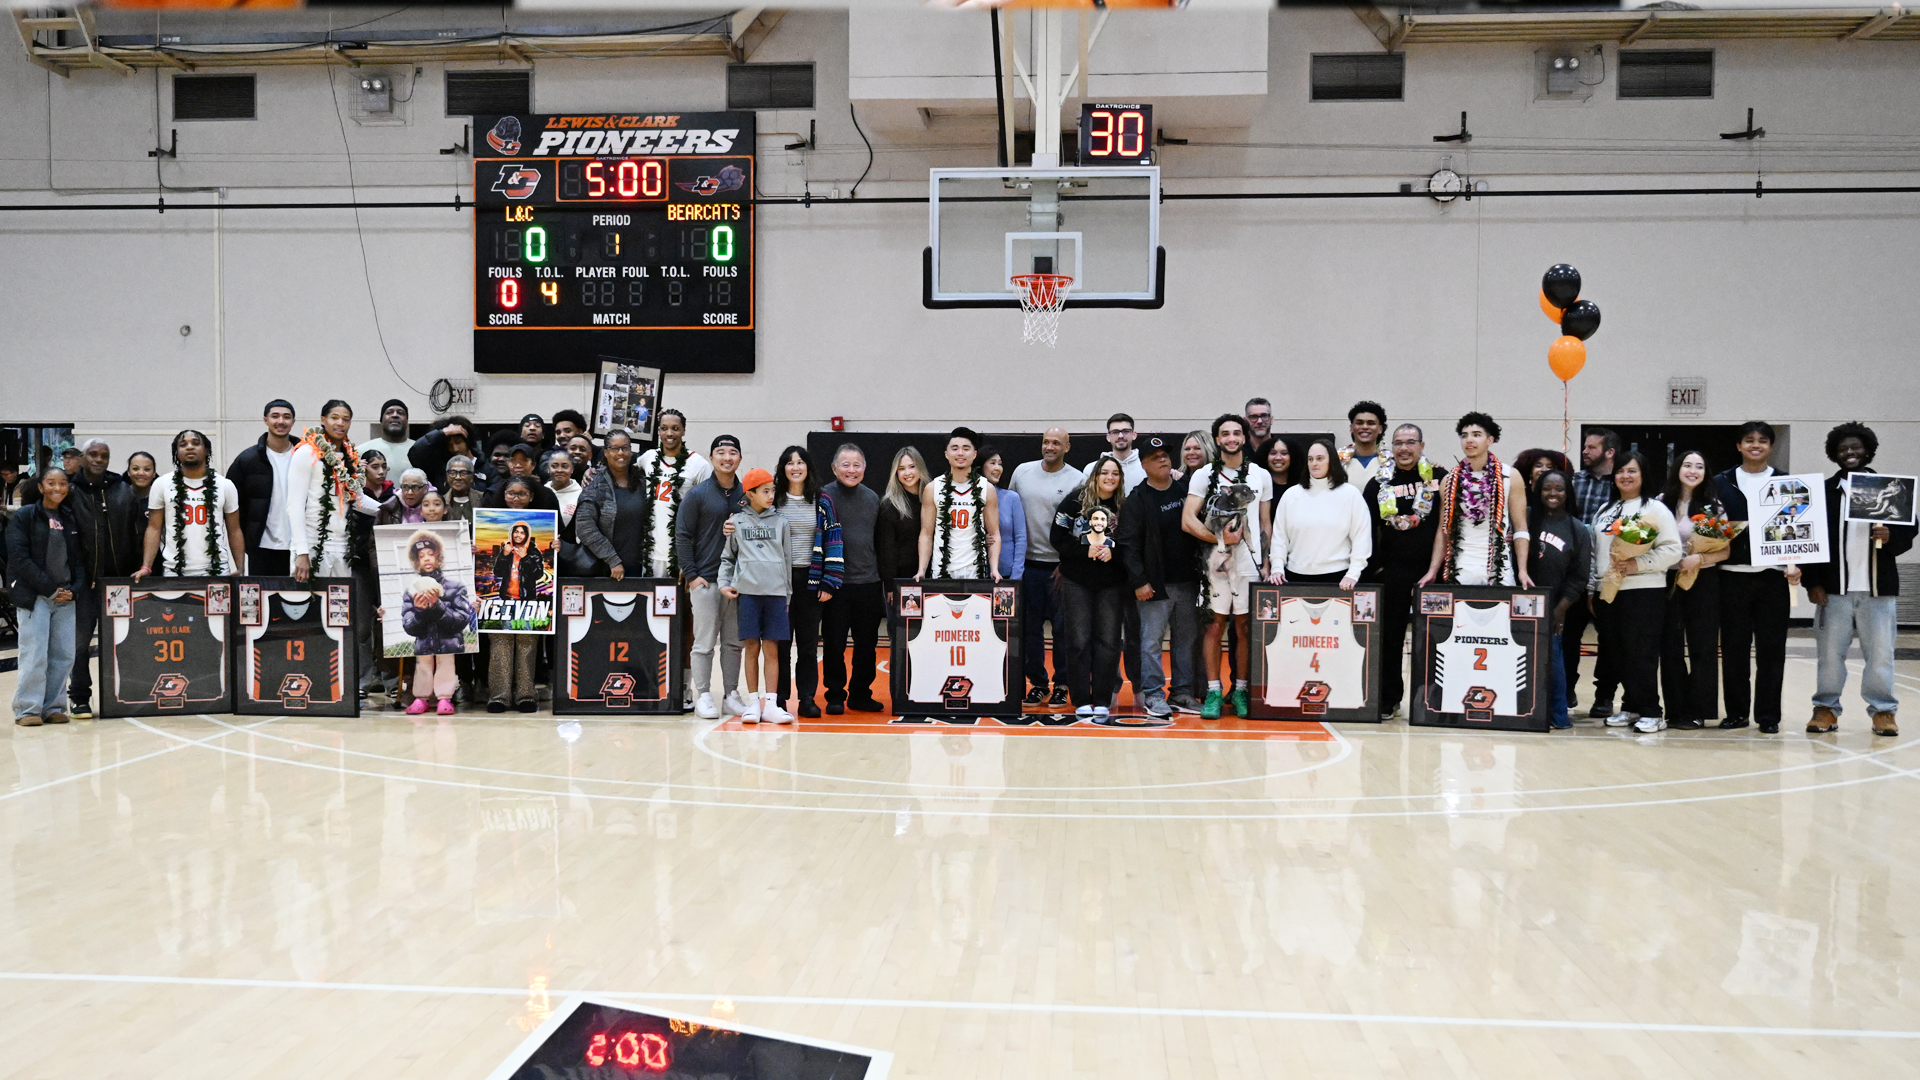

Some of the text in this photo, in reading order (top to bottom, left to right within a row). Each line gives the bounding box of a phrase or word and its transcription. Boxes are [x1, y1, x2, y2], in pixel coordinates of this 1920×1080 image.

[532, 129, 740, 156] PIONEERS
[1090, 112, 1143, 157] 30
[585, 161, 662, 198] 5:00
[505, 205, 534, 221] L&C
[593, 215, 631, 227] PERIOD
[667, 204, 741, 221] BEARCATS
[525, 226, 547, 263] 0
[614, 233, 620, 255] 1
[711, 225, 734, 262] 0
[488, 267, 522, 279] FOULS
[535, 267, 564, 279] T.O.L.
[575, 266, 649, 278] PLAYER FOUL
[661, 266, 690, 278] T.O.L.
[703, 266, 738, 278] FOULS
[501, 279, 518, 307] 0
[541, 281, 558, 305] 4
[488, 313, 523, 325] SCORE
[593, 313, 630, 325] MATCH
[703, 313, 738, 325] SCORE
[452, 388, 475, 404] EXIT
[1671, 388, 1699, 405] EXIT
[182, 504, 207, 525] 30
[951, 509, 969, 529] 10
[745, 529, 772, 540] LIBERTY
[1760, 542, 1820, 556] TAIEN JACKSON
[478, 600, 551, 622] KEIVON
[146, 627, 164, 635] LEWIS
[171, 626, 191, 634] CLARK
[935, 630, 980, 642] PIONEERS
[1292, 635, 1339, 648] PIONEERS
[1453, 635, 1508, 645] PIONEERS
[154, 640, 184, 662] 30
[286, 640, 305, 661] 13
[610, 641, 629, 662] 12
[950, 646, 965, 666] 10
[1309, 652, 1320, 673] 4
[1473, 648, 1488, 671] 2
